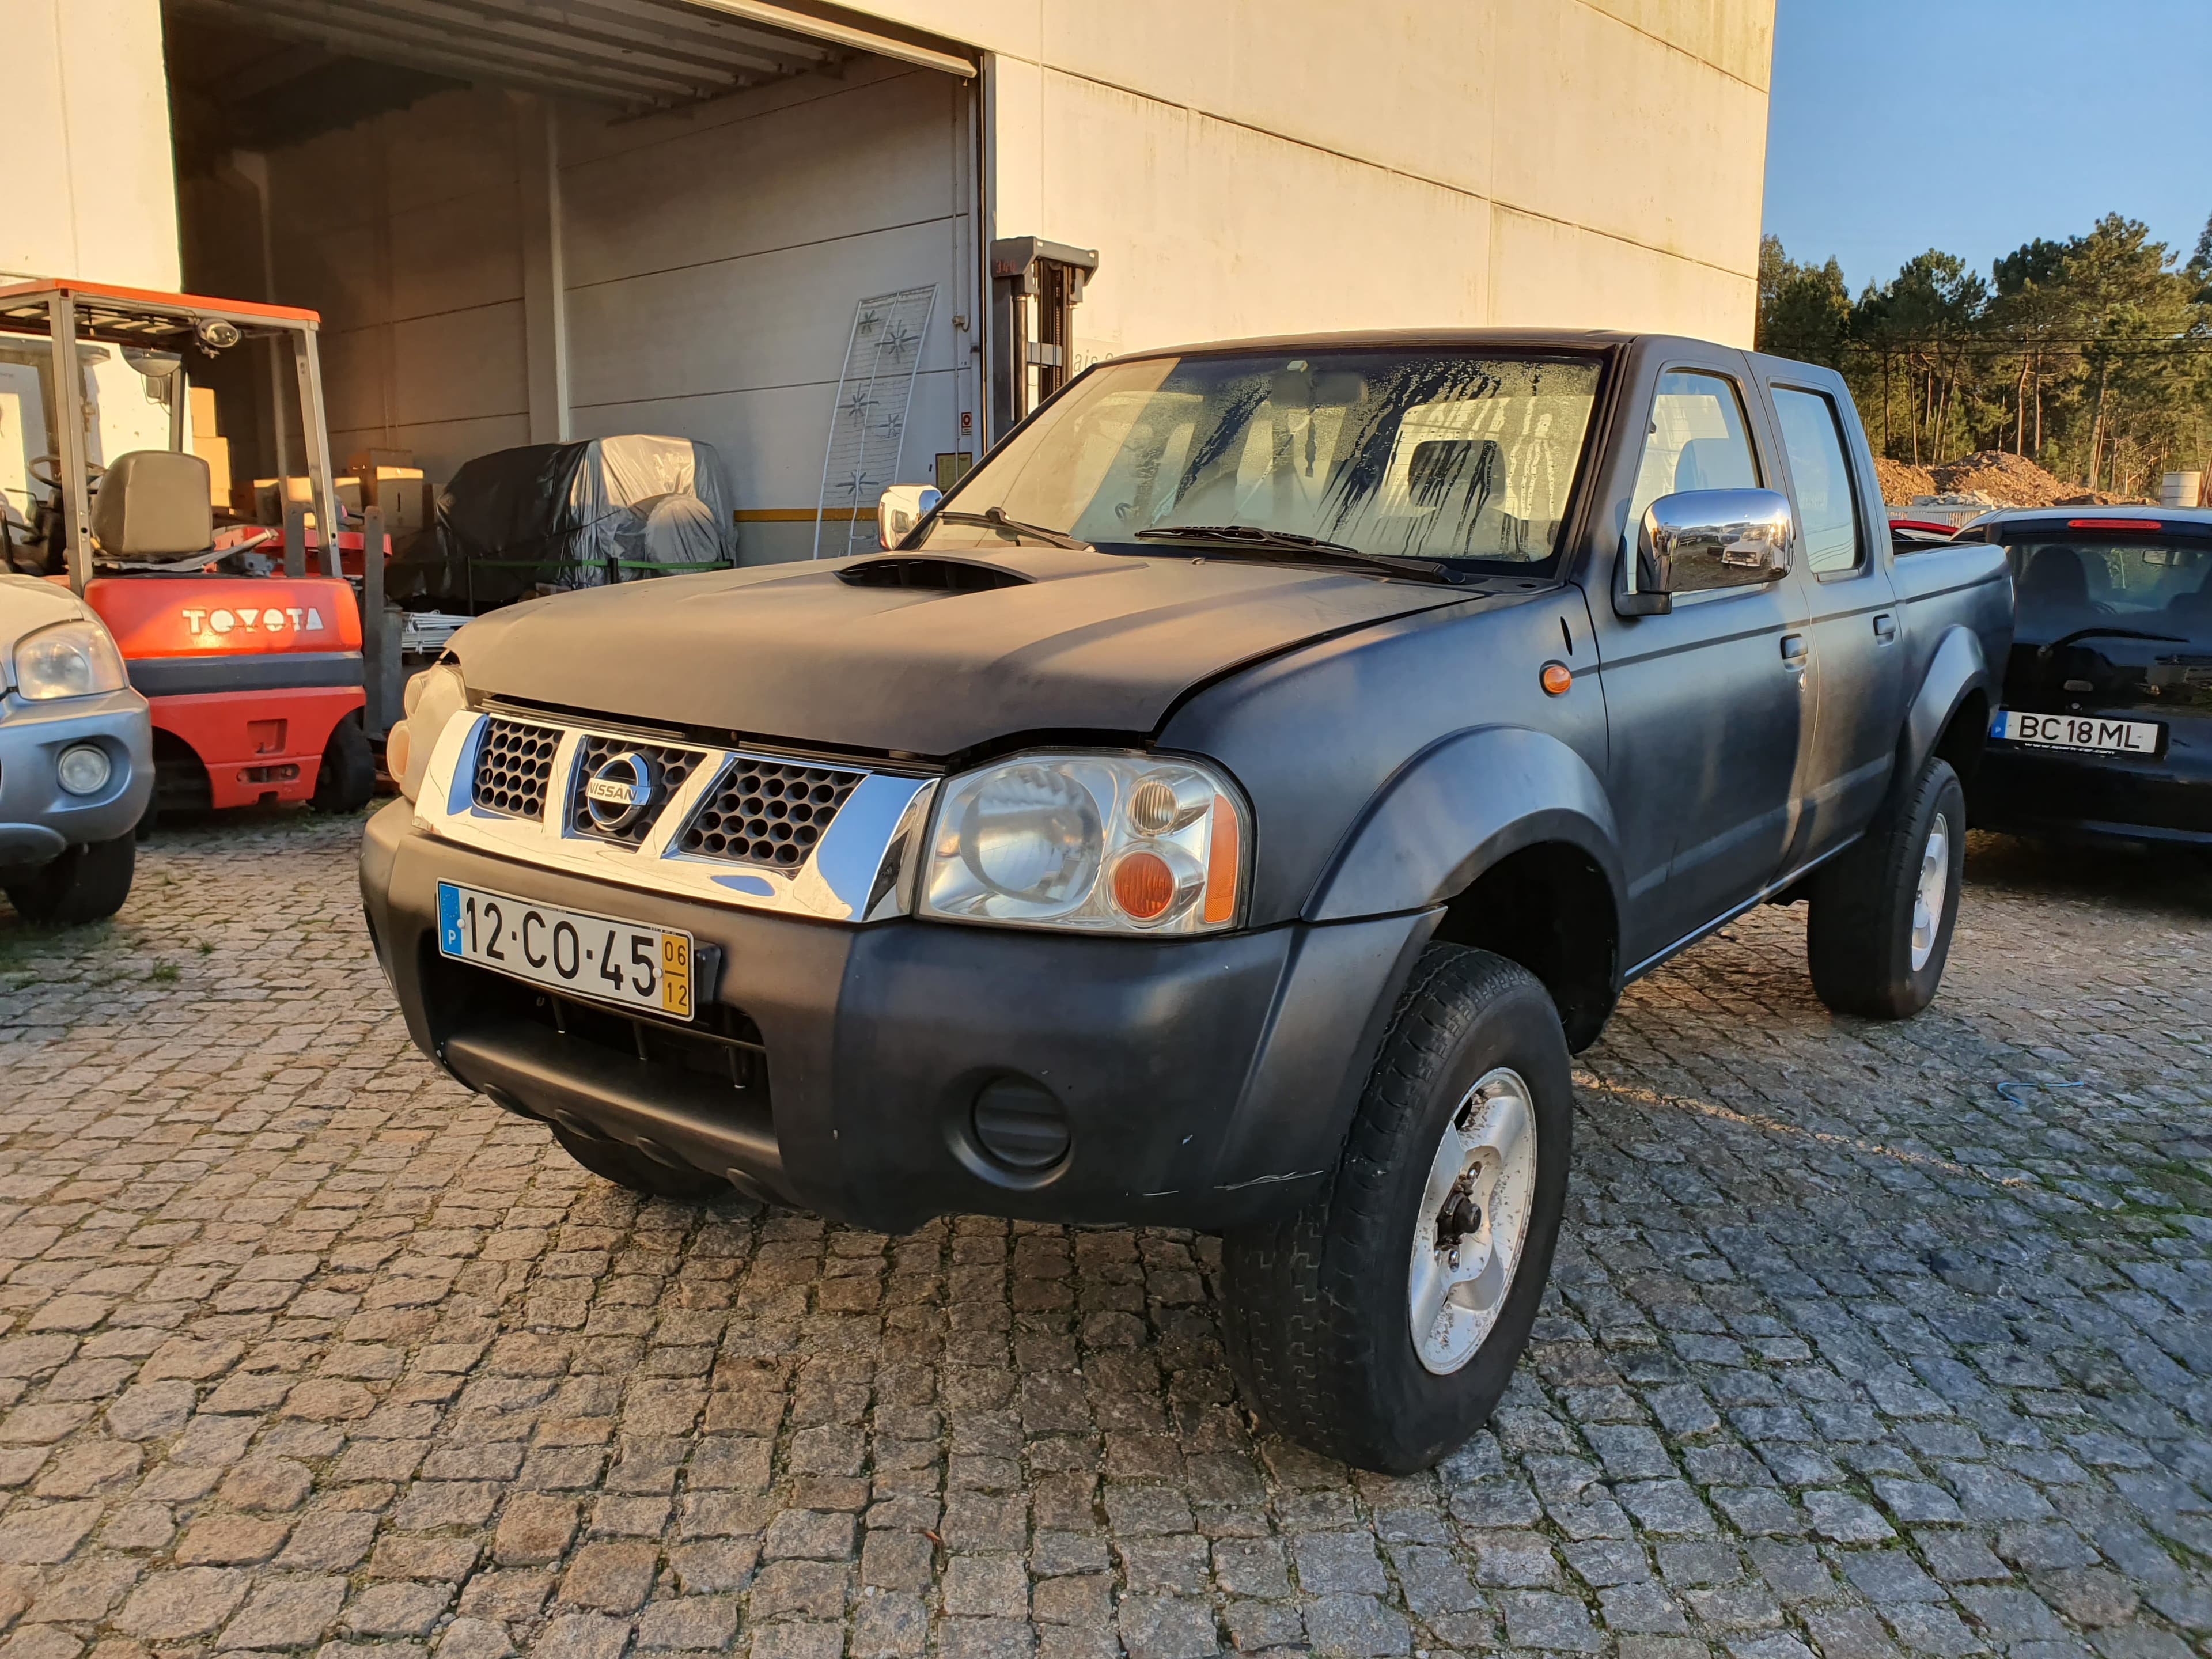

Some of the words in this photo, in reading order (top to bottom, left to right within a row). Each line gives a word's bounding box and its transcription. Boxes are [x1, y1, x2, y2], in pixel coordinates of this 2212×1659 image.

[182, 608, 324, 634] TOYOTA
[587, 782, 638, 801] NISSAN
[448, 929, 456, 945] P
[664, 940, 686, 966] 06
[667, 982, 687, 1007] 12
